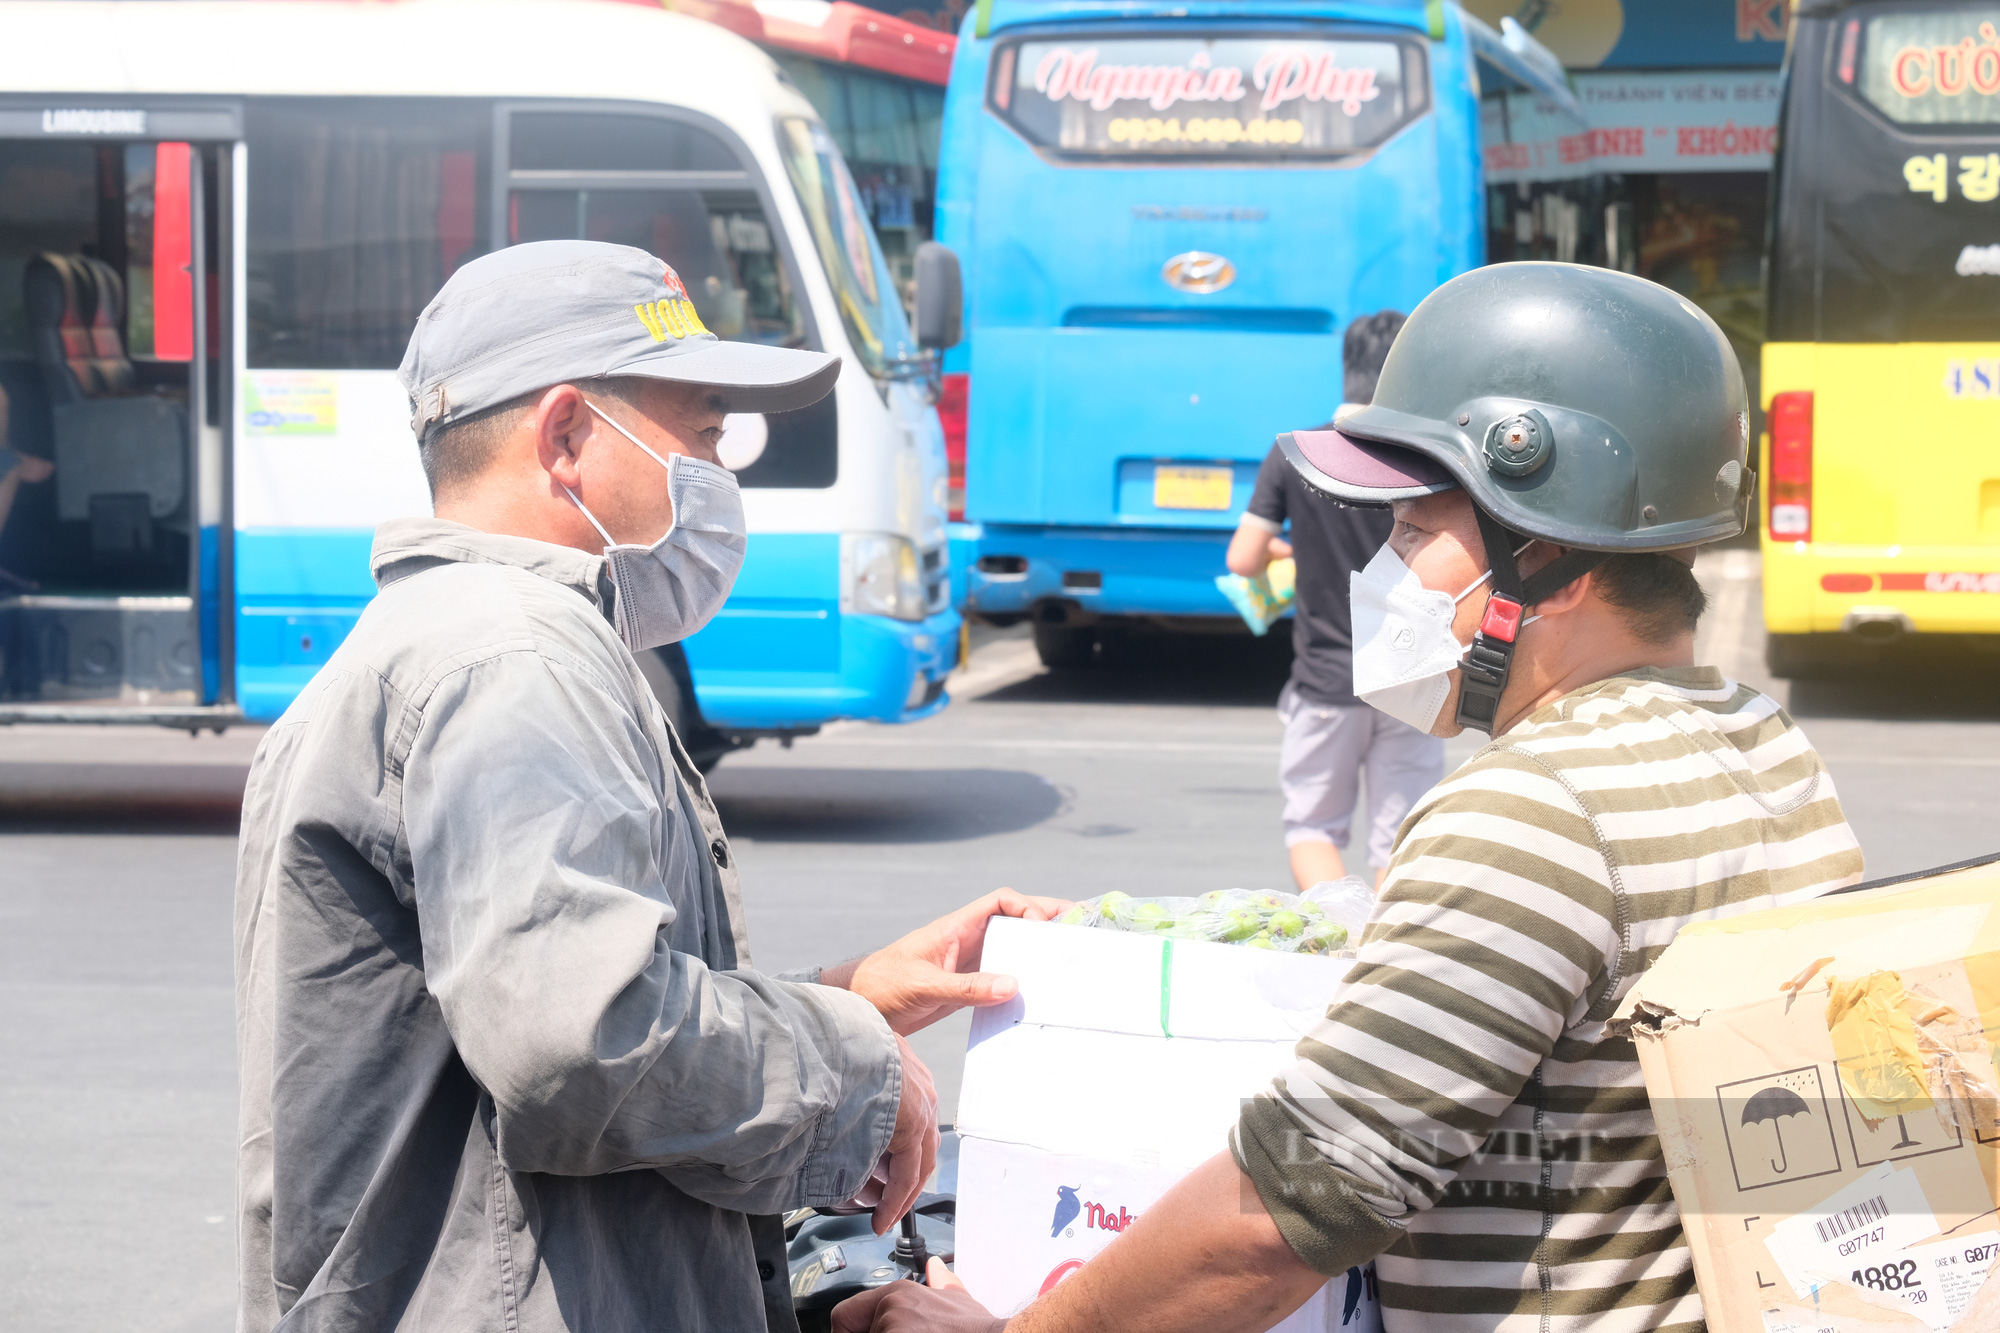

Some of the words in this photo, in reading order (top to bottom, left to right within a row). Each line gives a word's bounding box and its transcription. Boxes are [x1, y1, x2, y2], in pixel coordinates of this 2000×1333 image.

[1035, 47, 1247, 112] Nguyên
[1253, 49, 1381, 118] Phụ
[42, 108, 147, 134] LIMOUSINE
[1943, 358, 2000, 398] 48
[1084, 1201, 1139, 1232] Nak
[1838, 1227, 1885, 1257] G07747
[1934, 1257, 1949, 1268] CASE
[1901, 1290, 1928, 1304] 20
